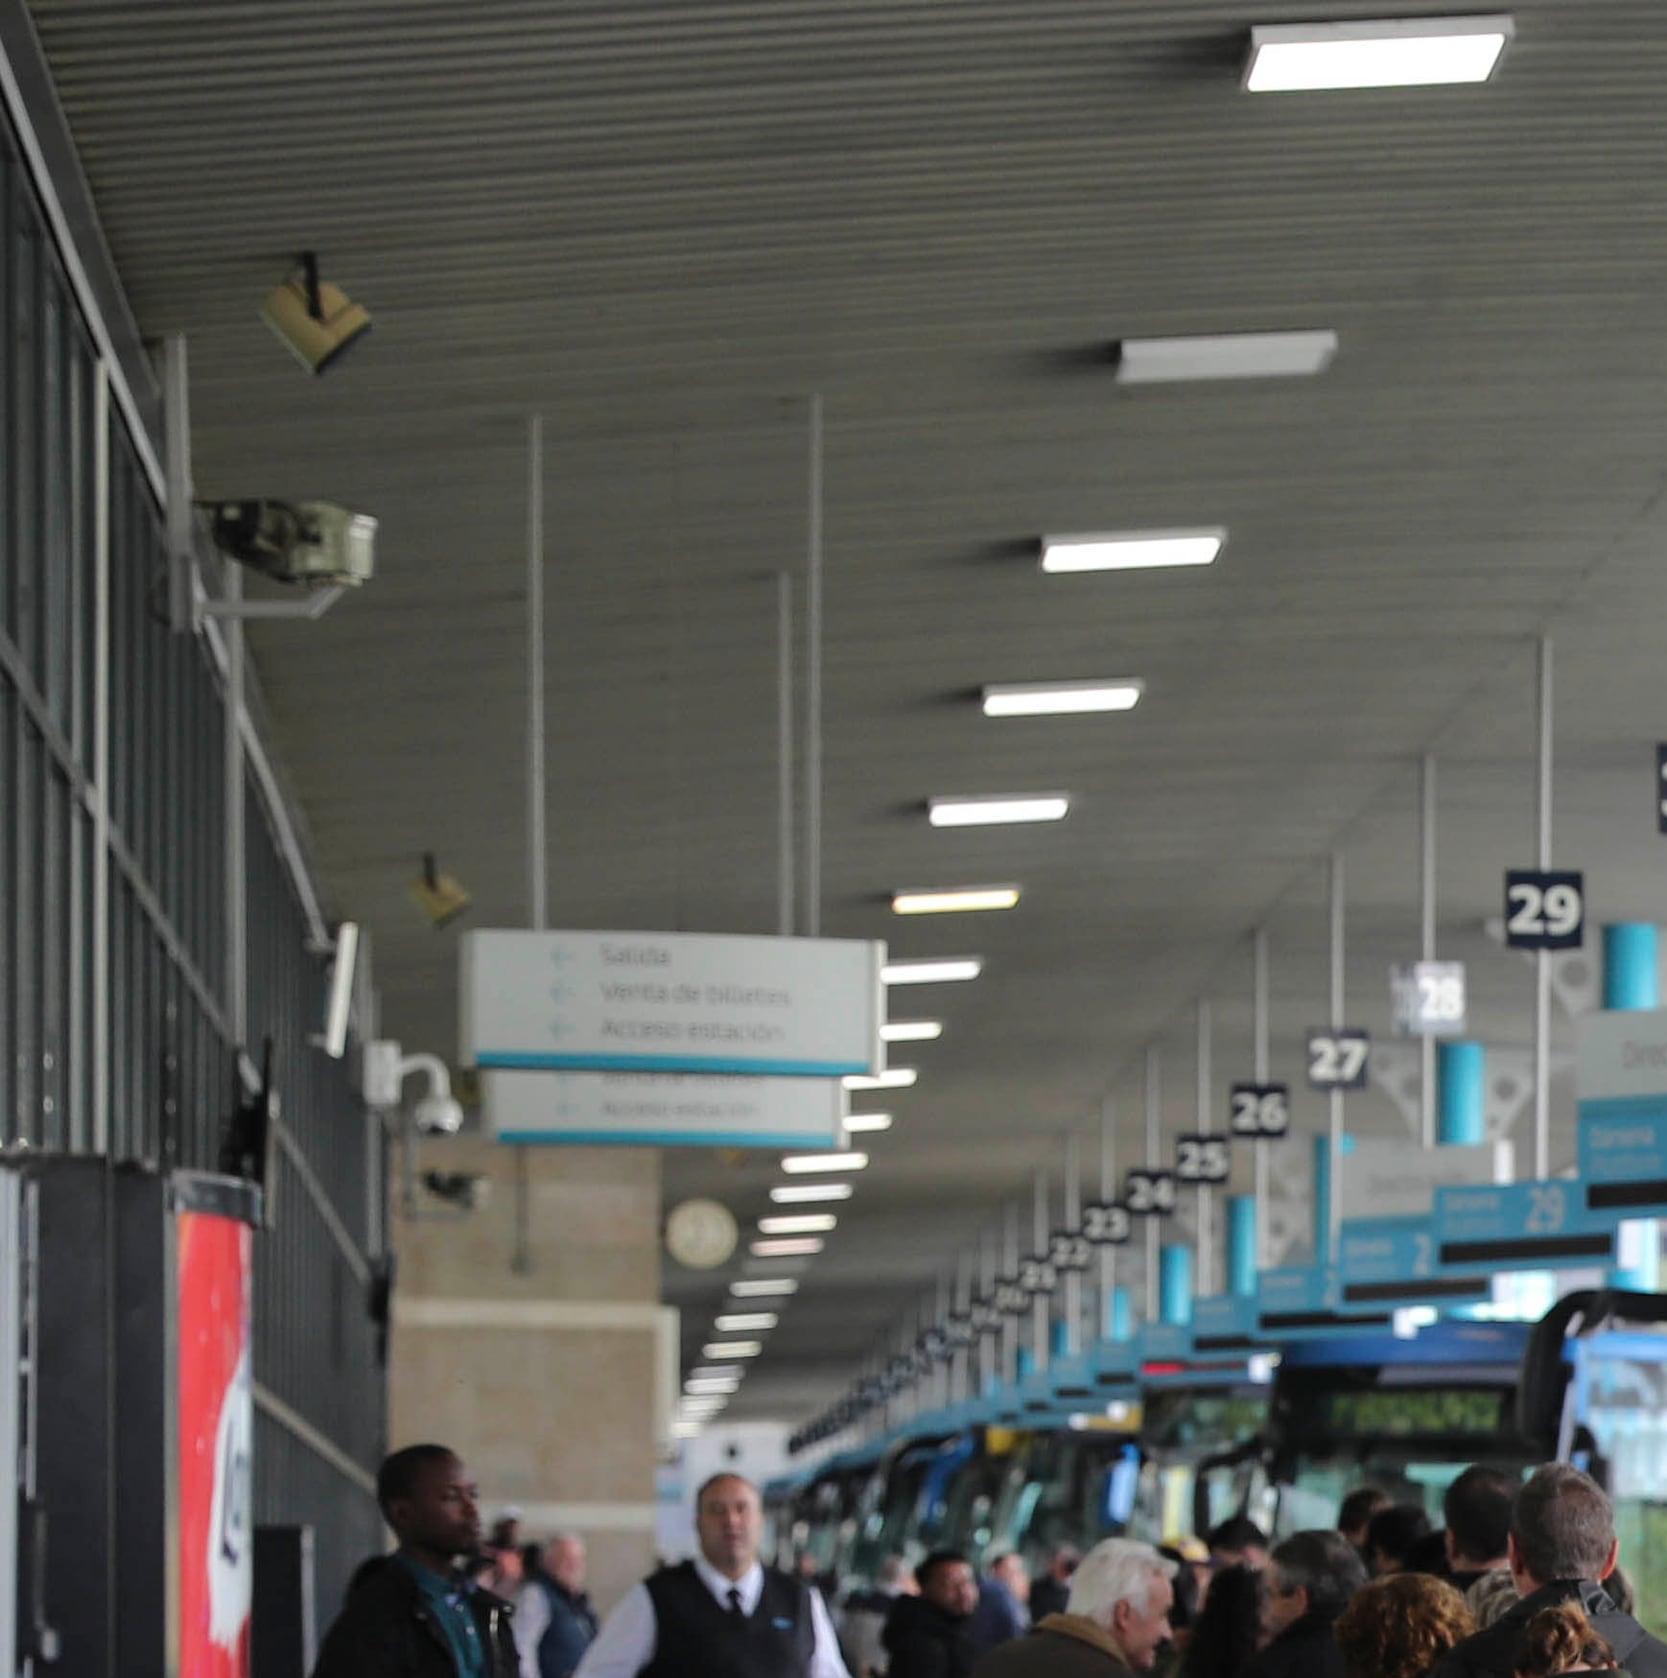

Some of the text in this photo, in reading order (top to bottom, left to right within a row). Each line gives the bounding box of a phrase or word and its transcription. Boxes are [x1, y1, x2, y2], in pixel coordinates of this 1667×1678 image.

[1507, 884, 1581, 935] 29
[1416, 975, 1465, 1020] 28
[1308, 1037, 1368, 1082] 27
[1231, 1090, 1287, 1134] 26
[1177, 1140, 1228, 1180] 25
[1128, 1175, 1175, 1213] 24
[1524, 1186, 1566, 1233] 29
